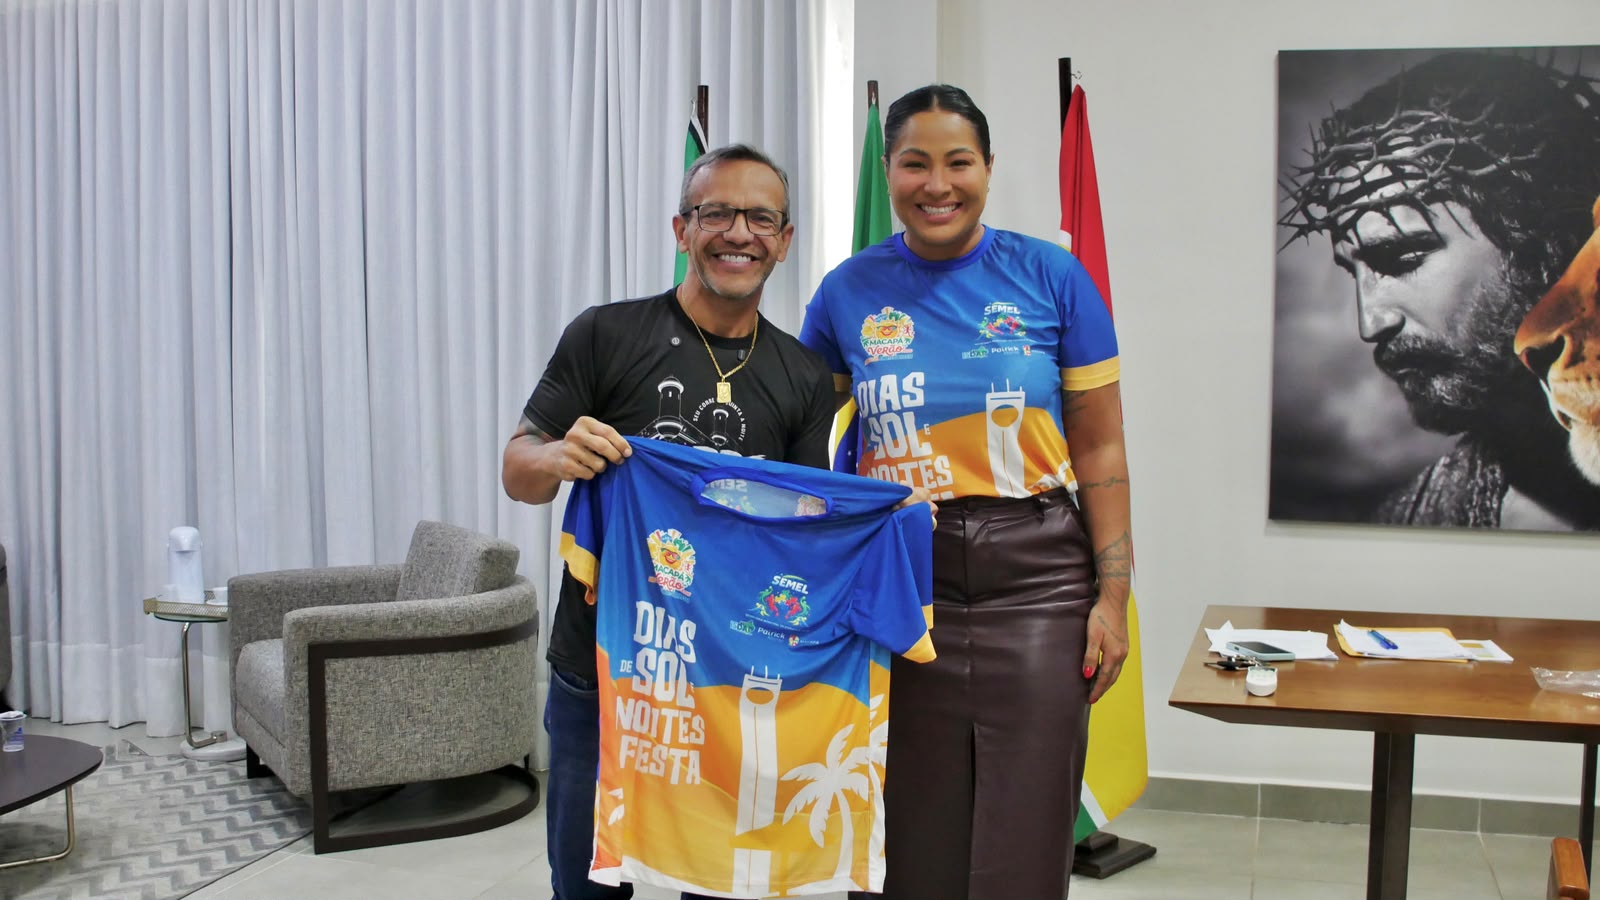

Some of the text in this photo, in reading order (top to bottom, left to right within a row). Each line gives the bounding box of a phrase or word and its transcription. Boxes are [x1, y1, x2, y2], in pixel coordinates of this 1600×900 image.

[984, 304, 1020, 315] SEMEL
[869, 338, 903, 346] MACAPÁ
[692, 410, 701, 422] SEU
[857, 371, 925, 419] DIAS
[867, 411, 933, 460] SOL E
[772, 575, 809, 595] SEMEL
[633, 600, 697, 663] DIAS
[619, 647, 696, 709] DE SOL
[616, 695, 705, 745] NOITES
[619, 734, 701, 785] FESTA
